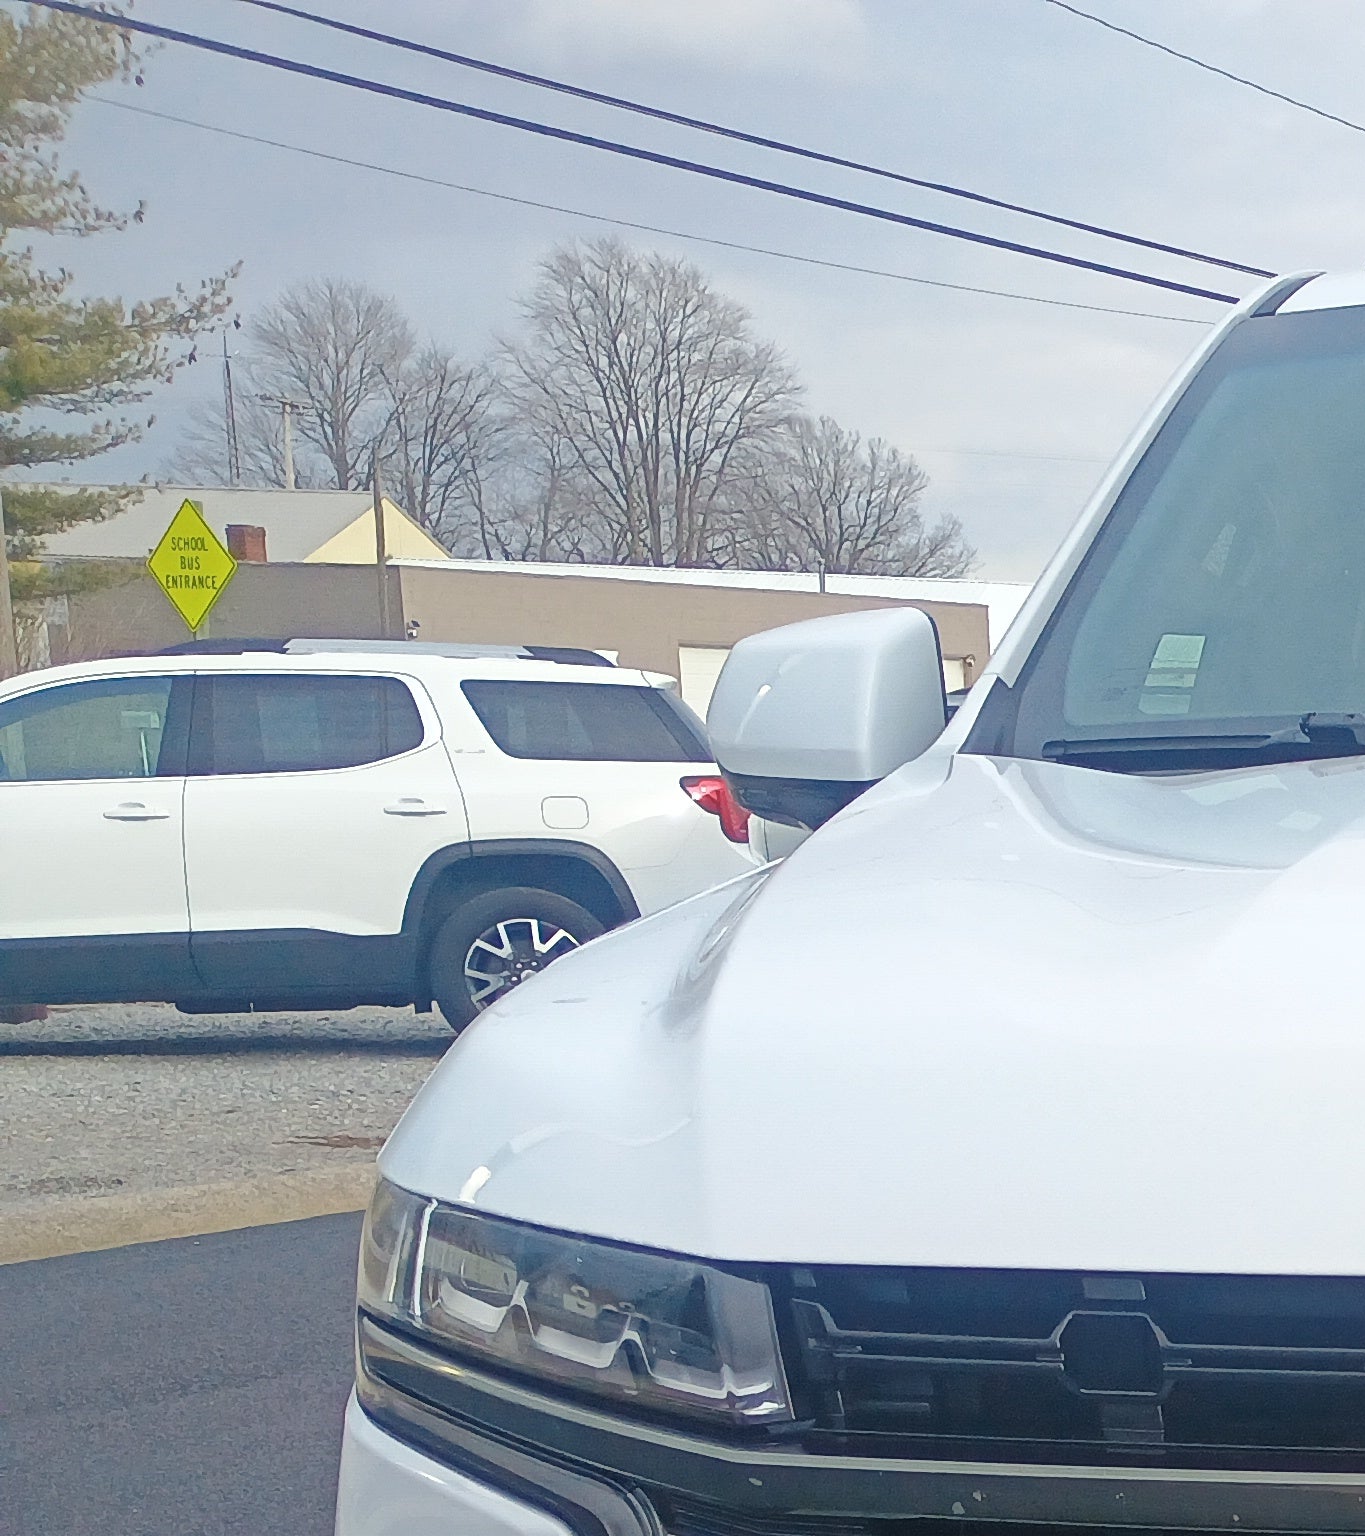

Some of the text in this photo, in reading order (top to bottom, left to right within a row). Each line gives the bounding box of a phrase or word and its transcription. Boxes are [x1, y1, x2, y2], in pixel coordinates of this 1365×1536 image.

[171, 536, 209, 552] SCHOOL
[179, 556, 201, 571] BUS
[165, 574, 218, 590] ENTRANCE
